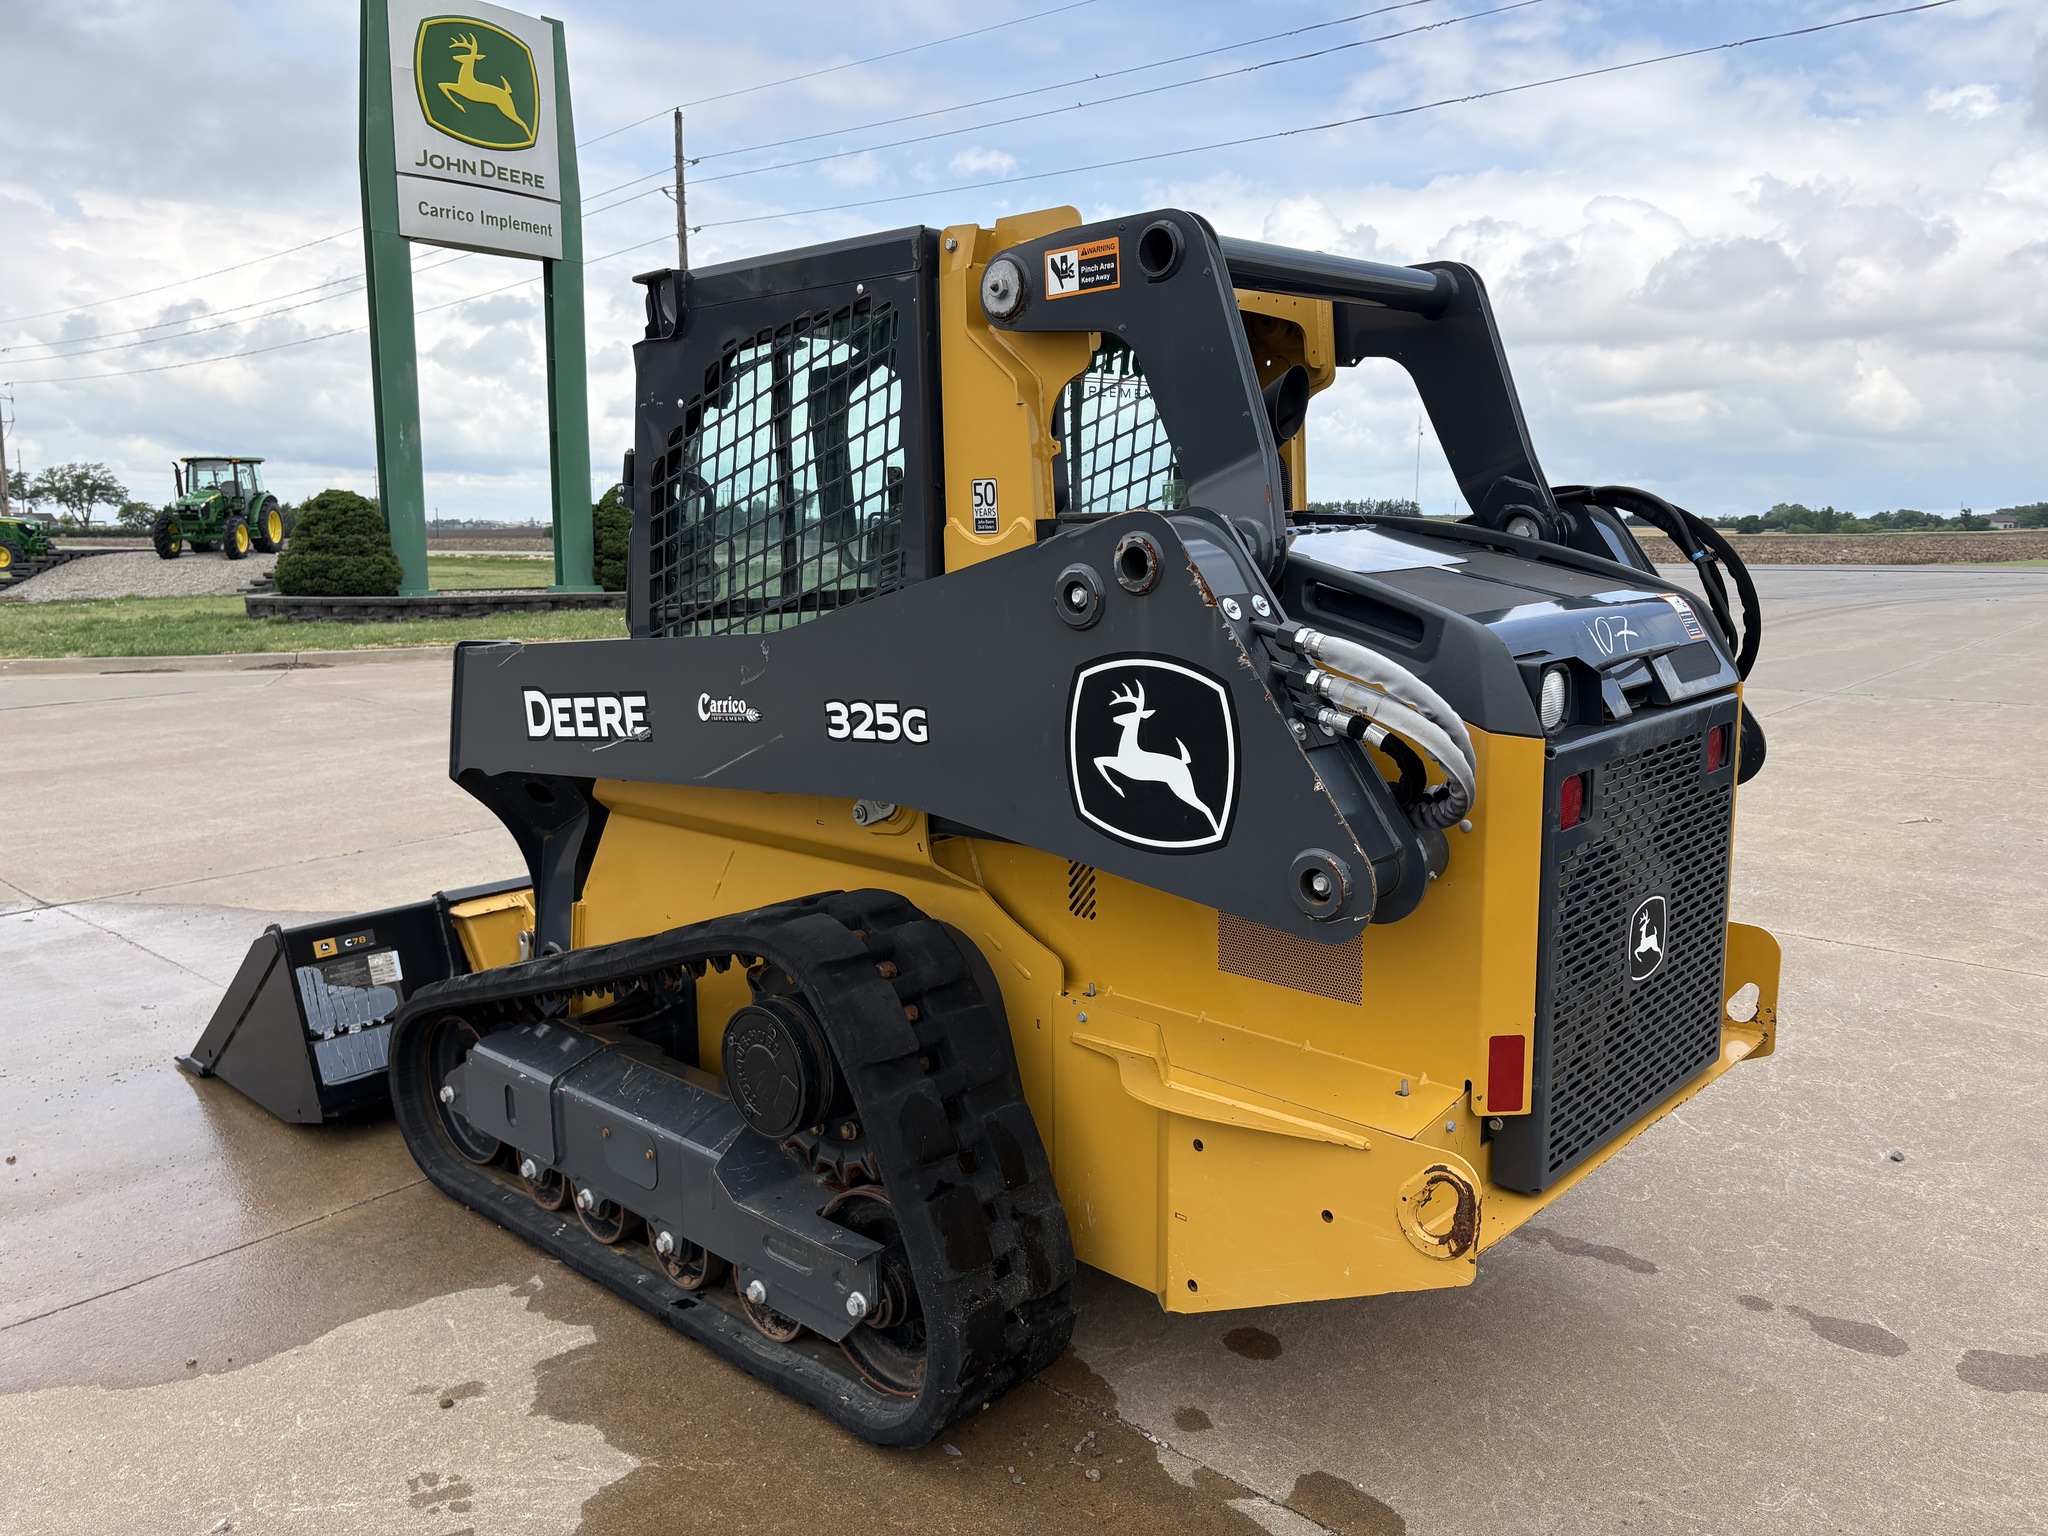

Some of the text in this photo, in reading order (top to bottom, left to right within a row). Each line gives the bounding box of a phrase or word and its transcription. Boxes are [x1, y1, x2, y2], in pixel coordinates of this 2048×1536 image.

[415, 149, 545, 189] JOHN DEERE
[418, 201, 553, 237] Carrico Implement
[1087, 243, 1115, 254] WARNING
[1081, 262, 1115, 273] Pinch Area
[1081, 276, 1095, 284] Keep
[973, 482, 995, 507] 50
[974, 507, 996, 517] YEARS
[523, 690, 649, 737] DEERE
[698, 693, 746, 721] Carrico
[826, 702, 928, 743] 325G
[344, 936, 367, 947] C78
